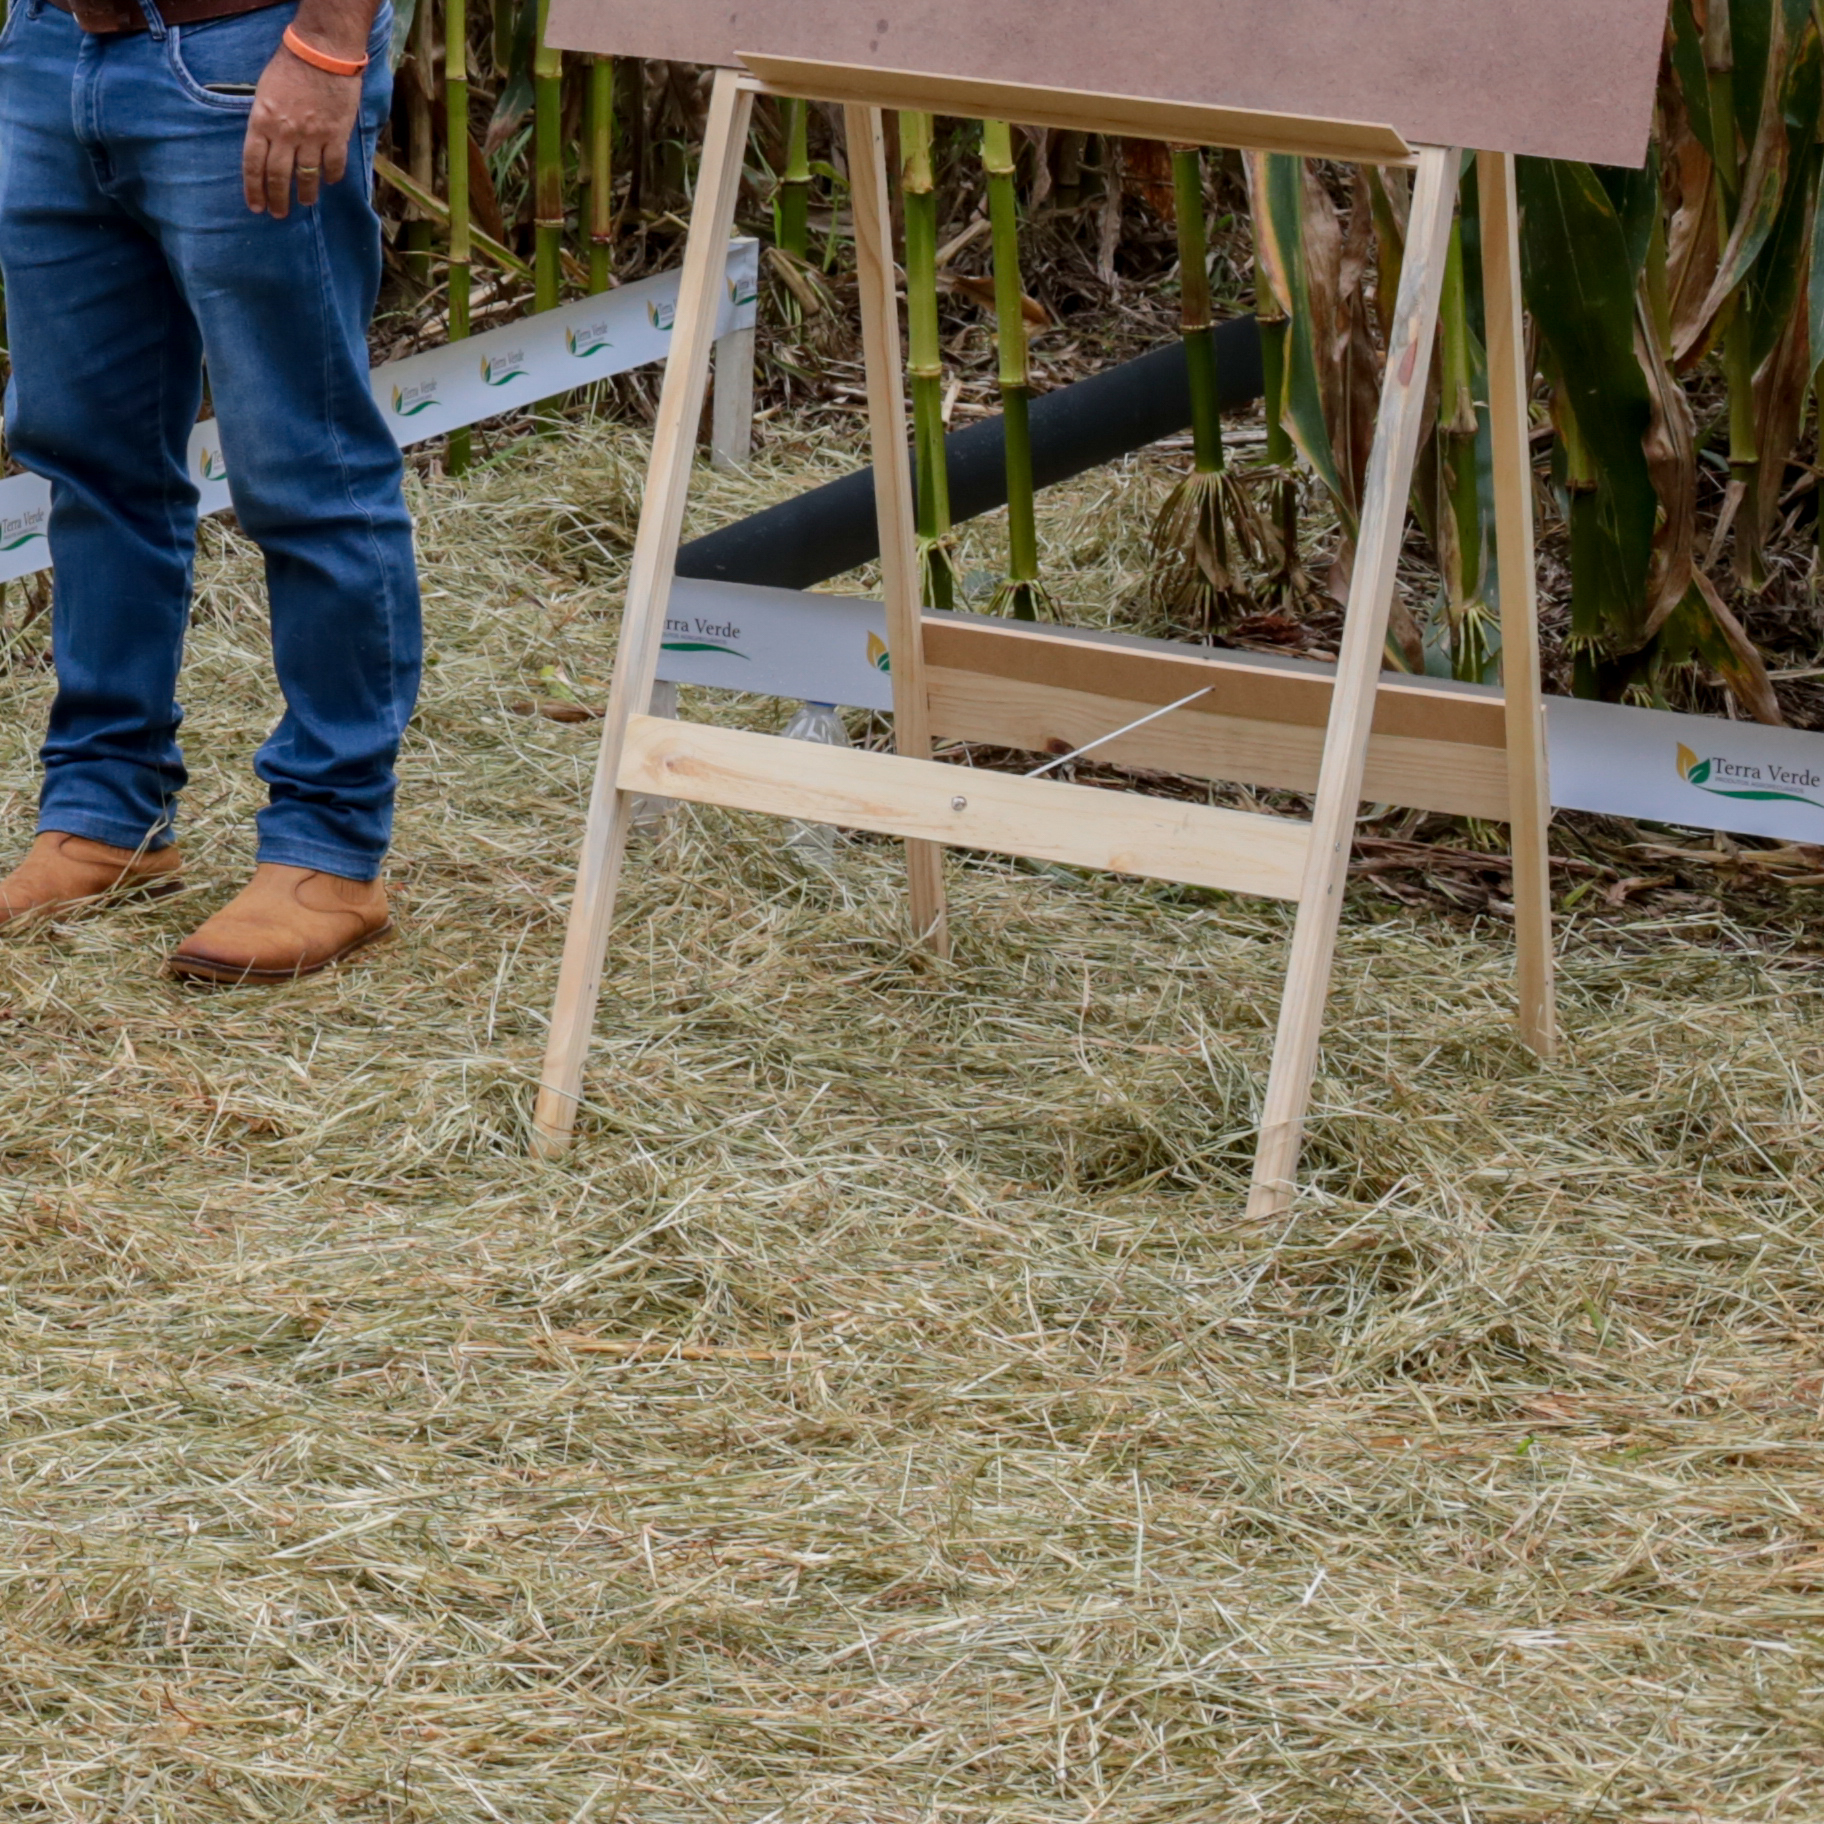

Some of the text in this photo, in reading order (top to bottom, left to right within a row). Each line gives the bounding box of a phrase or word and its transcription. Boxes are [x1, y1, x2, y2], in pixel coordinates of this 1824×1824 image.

[2, 516, 22, 533] Terra
[23, 507, 45, 526] Verde
[664, 618, 740, 639] rra Verde
[1712, 757, 1820, 787] Terra Verde
